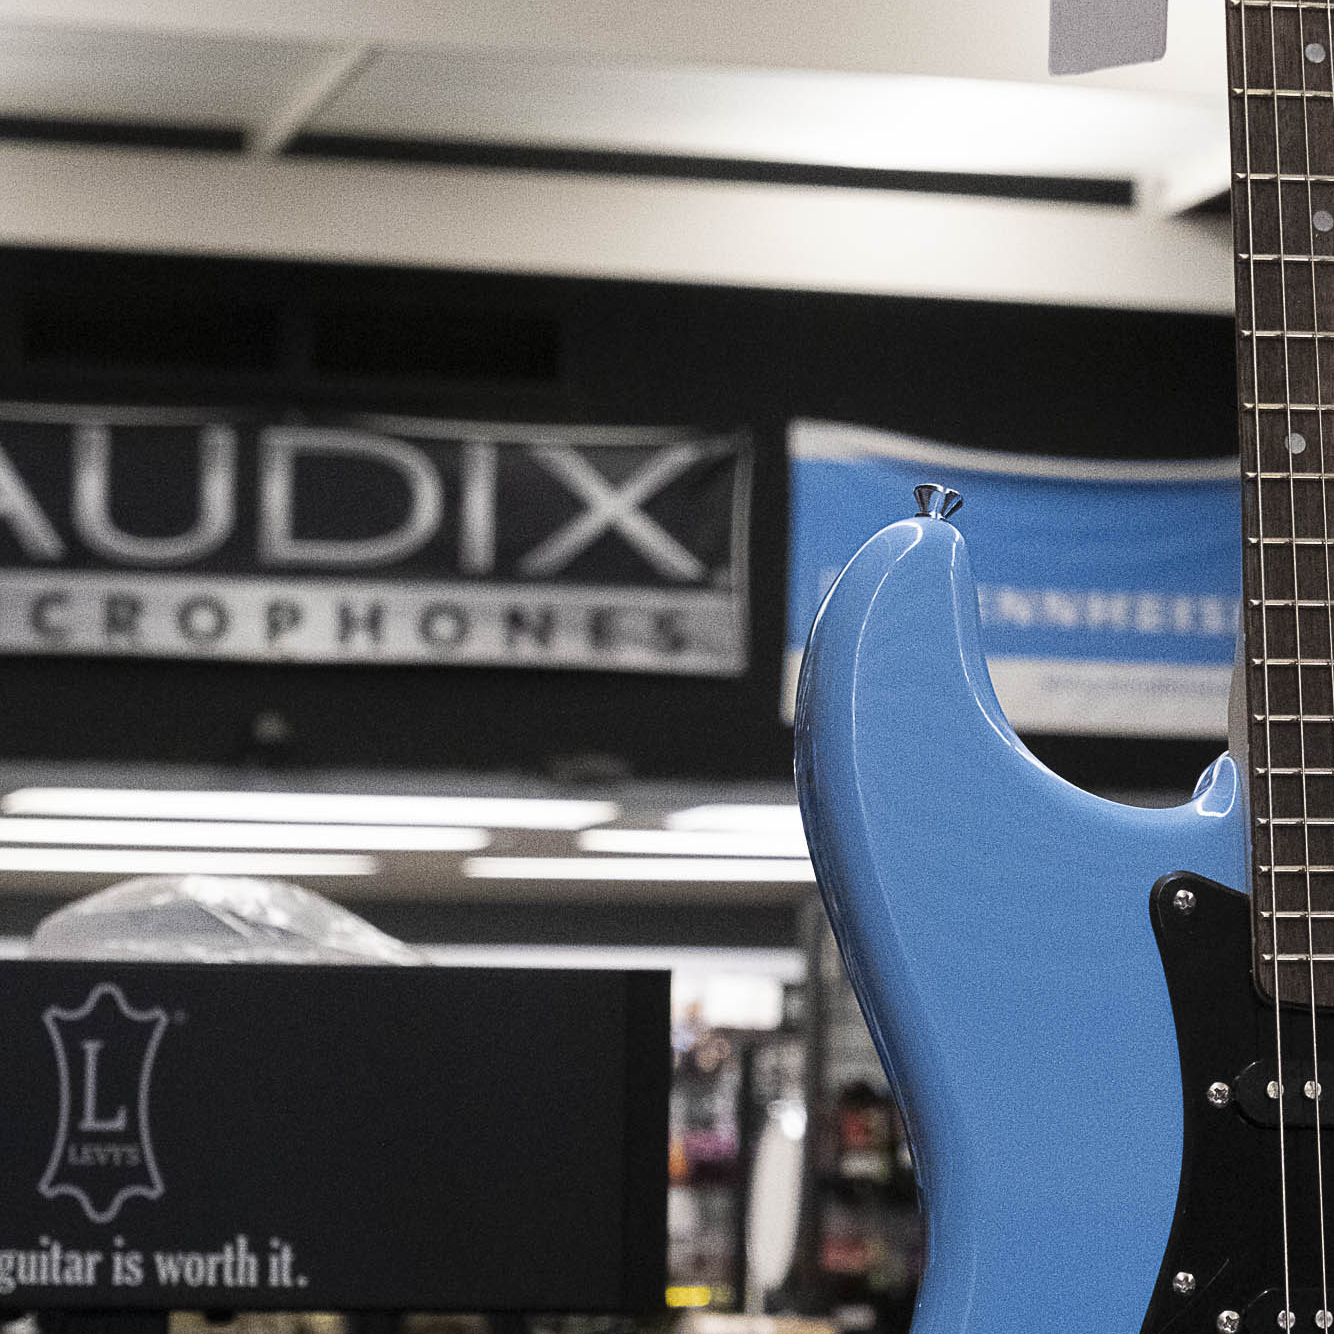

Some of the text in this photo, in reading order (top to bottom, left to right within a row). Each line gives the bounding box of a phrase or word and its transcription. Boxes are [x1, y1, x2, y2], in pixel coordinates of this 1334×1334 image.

[78, 1039, 128, 1133] L
[0, 1233, 309, 1295] guitar is worth it.
